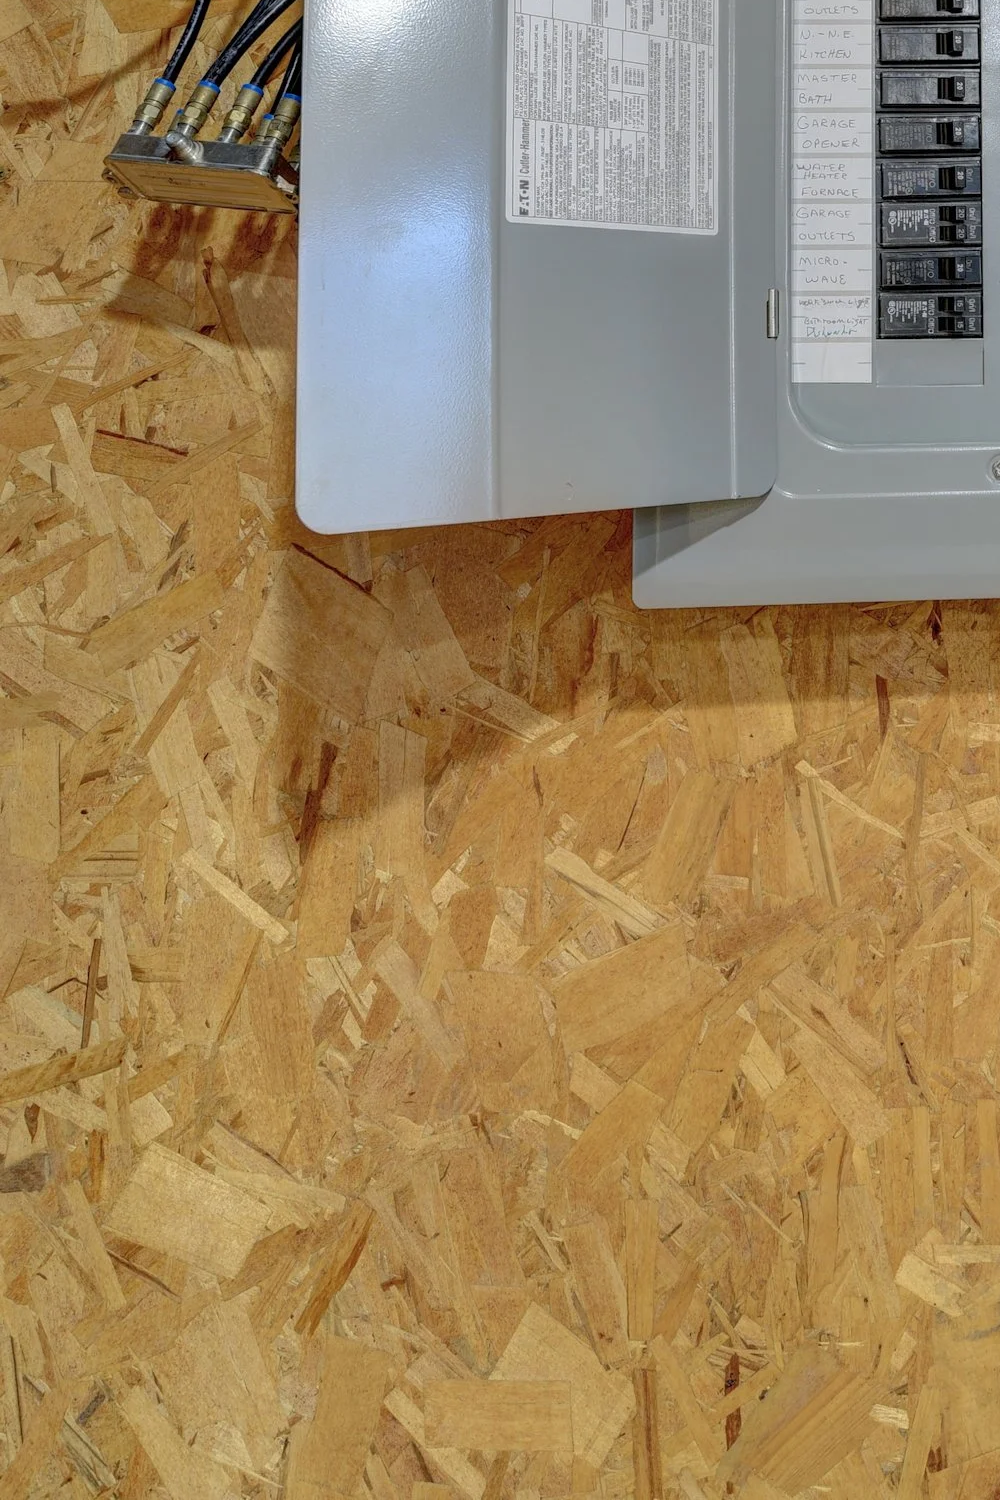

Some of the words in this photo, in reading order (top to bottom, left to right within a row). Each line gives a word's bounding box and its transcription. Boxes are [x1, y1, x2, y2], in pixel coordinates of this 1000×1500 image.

[803, 5, 859, 15] OUTLETS
[800, 49, 852, 60] KITCHEN
[797, 74, 857, 83] MASTER
[799, 93, 832, 104] BATH
[796, 116, 856, 129] GARAGE
[520, 120, 530, 174] Cutler-Hammer
[802, 138, 860, 149] OPENER
[796, 163, 846, 172] WATER
[803, 172, 848, 180] HEATER
[796, 207, 851, 218] GARAGE
[958, 208, 965, 219] 20
[799, 231, 856, 241] OUTLETS
[958, 228, 965, 239] 20
